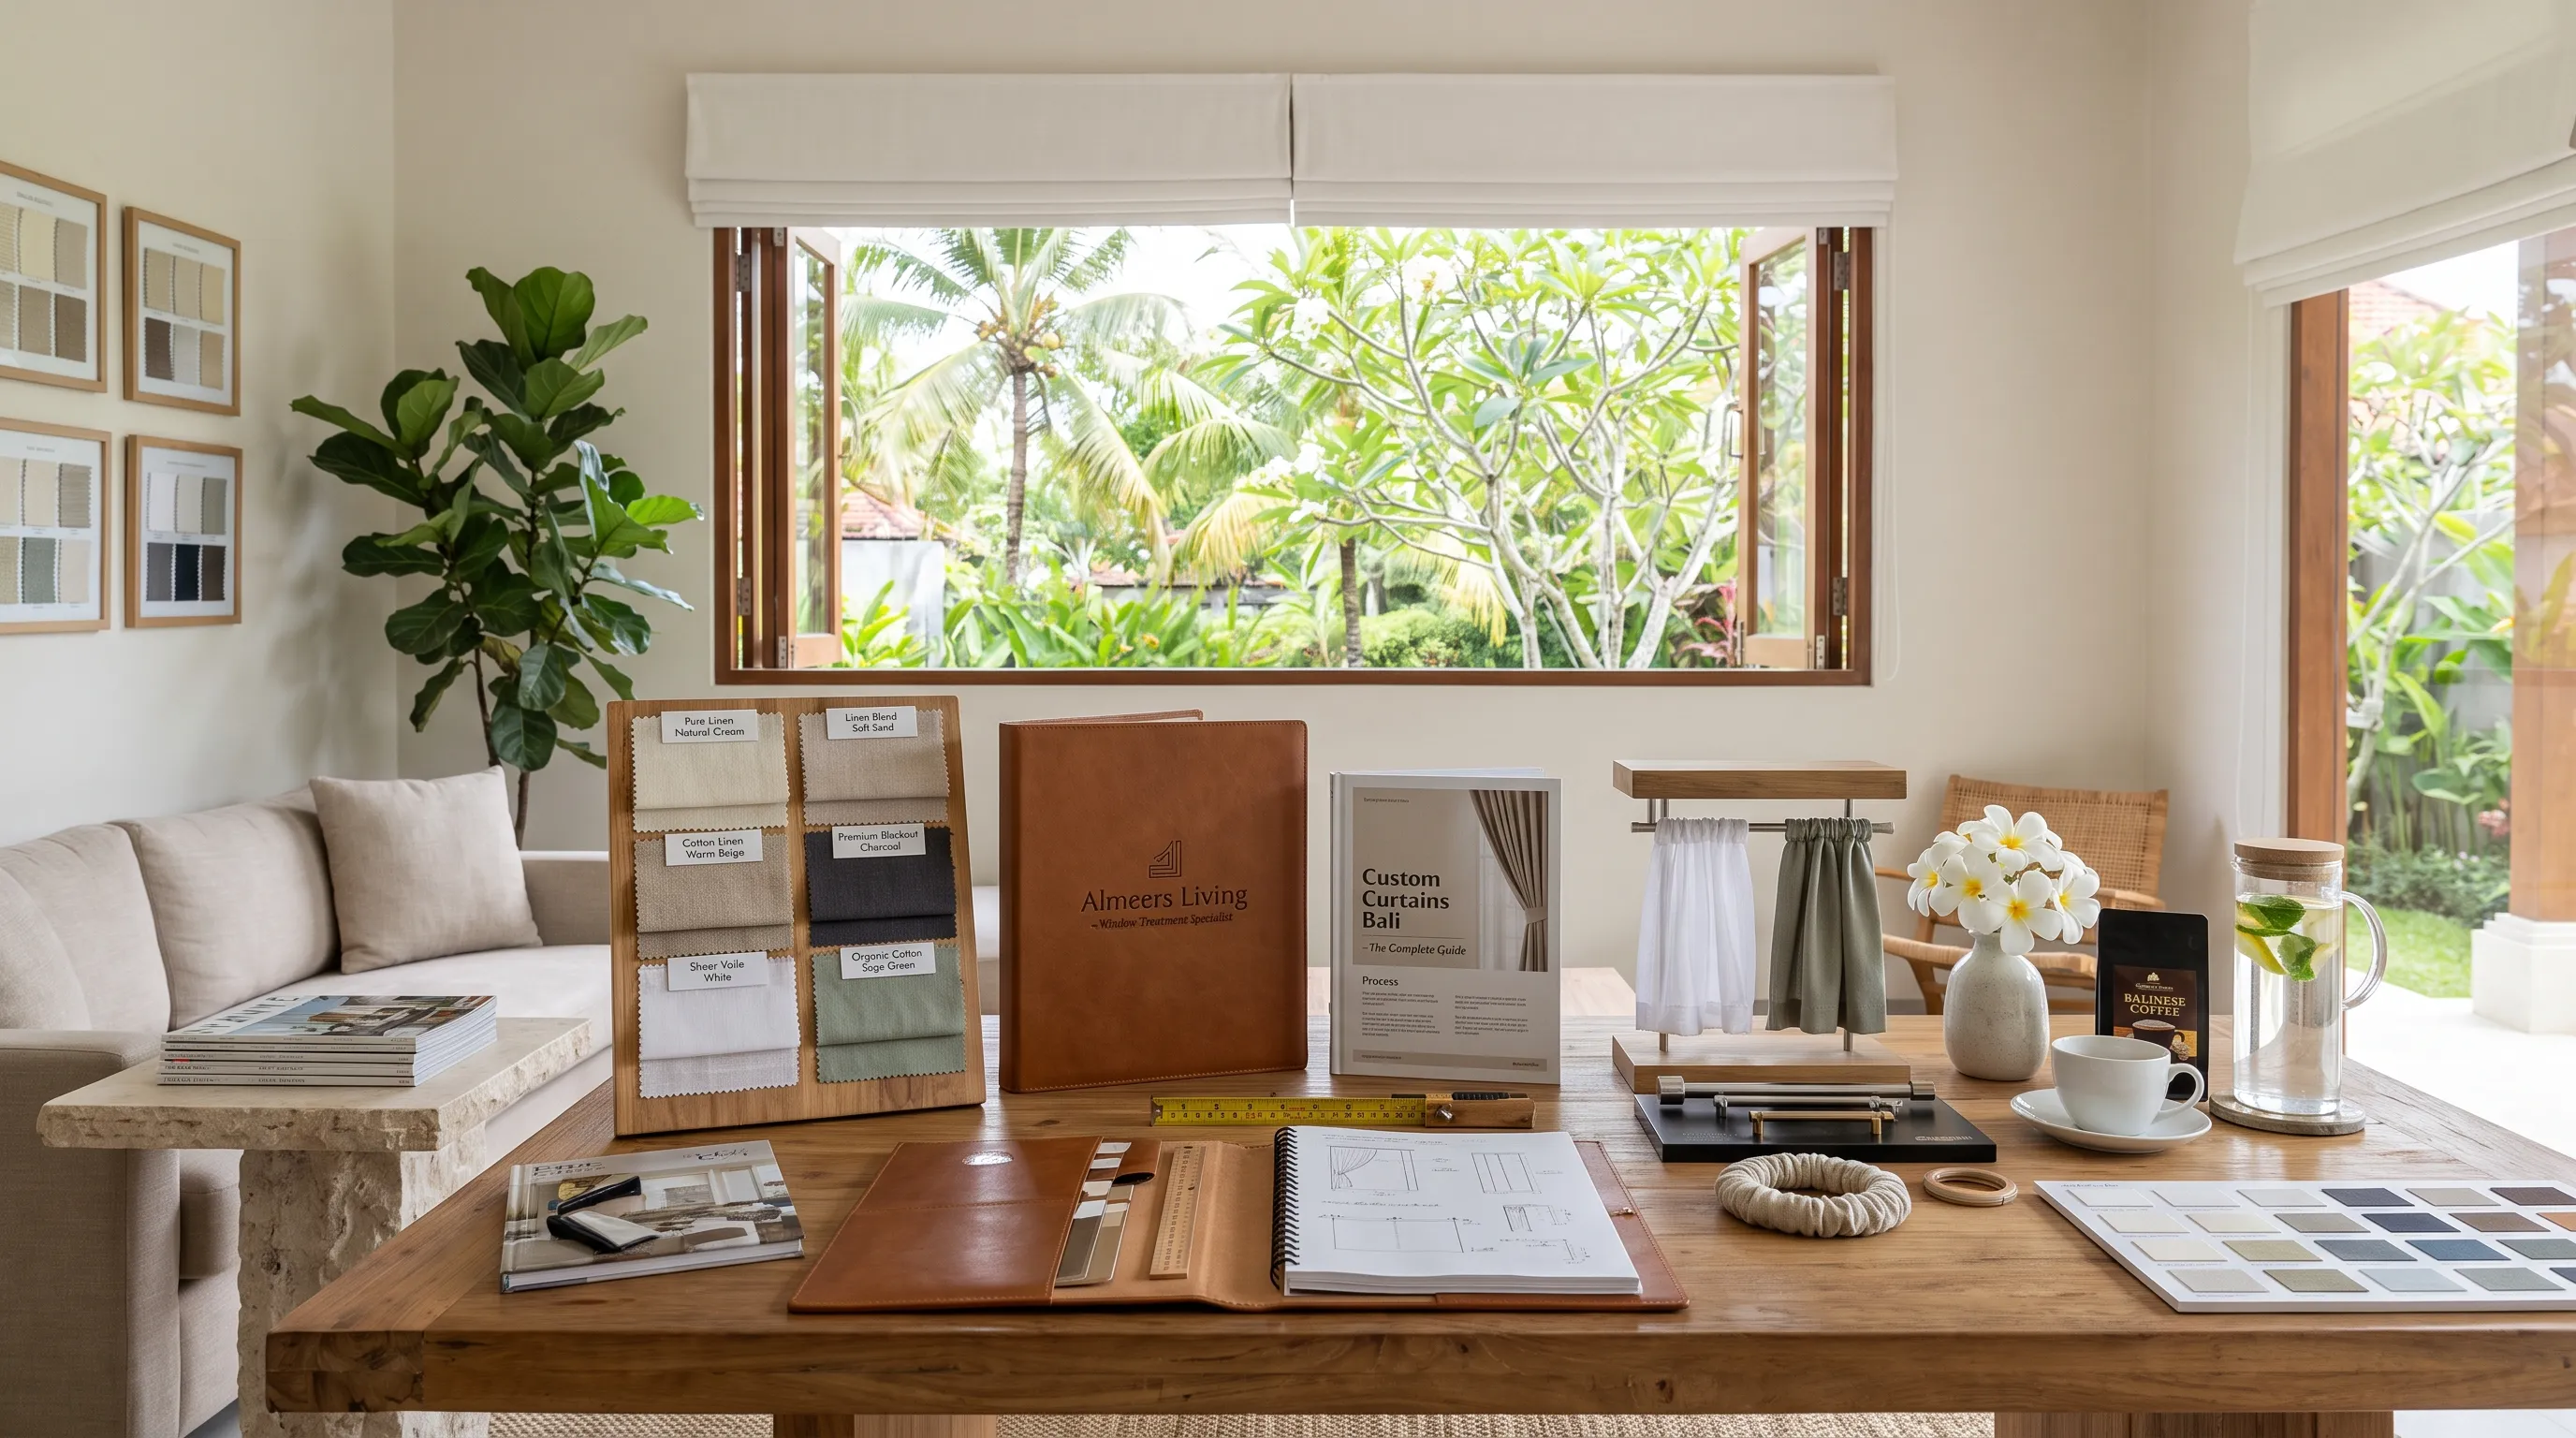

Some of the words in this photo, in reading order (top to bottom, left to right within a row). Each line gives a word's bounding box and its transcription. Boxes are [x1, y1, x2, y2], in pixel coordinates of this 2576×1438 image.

[872, 712, 897, 721] Blend
[675, 728, 710, 737] Natural
[713, 727, 744, 736] Cream
[852, 724, 870, 732] Soft
[872, 723, 894, 731] Sand
[839, 832, 877, 841] Premium
[881, 830, 918, 839] Blackout
[682, 839, 714, 847] Cotton
[719, 837, 743, 845] Linen
[860, 842, 900, 851] Charcoal
[686, 850, 715, 858] Warm
[719, 849, 744, 858] Beige
[1362, 868, 1441, 887] Custom
[1081, 889, 1173, 913] Almeers
[1181, 886, 1248, 910] Living
[1362, 890, 1450, 909] Curtains
[1099, 918, 1136, 930] Window
[1138, 917, 1189, 927] Treatment
[1190, 913, 1233, 924] Specialist
[1363, 911, 1400, 929] Bali
[892, 950, 922, 959] Cotton
[1369, 944, 1386, 952] The
[1388, 944, 1435, 955] Complete
[1437, 945, 1466, 956] Guide
[690, 962, 717, 971] Sheer
[721, 960, 744, 969] Voile
[887, 961, 915, 970] Green
[1362, 976, 1398, 986] Process
[2124, 993, 2186, 1006] BALINESE
[2130, 1005, 2180, 1016] COFFEE
